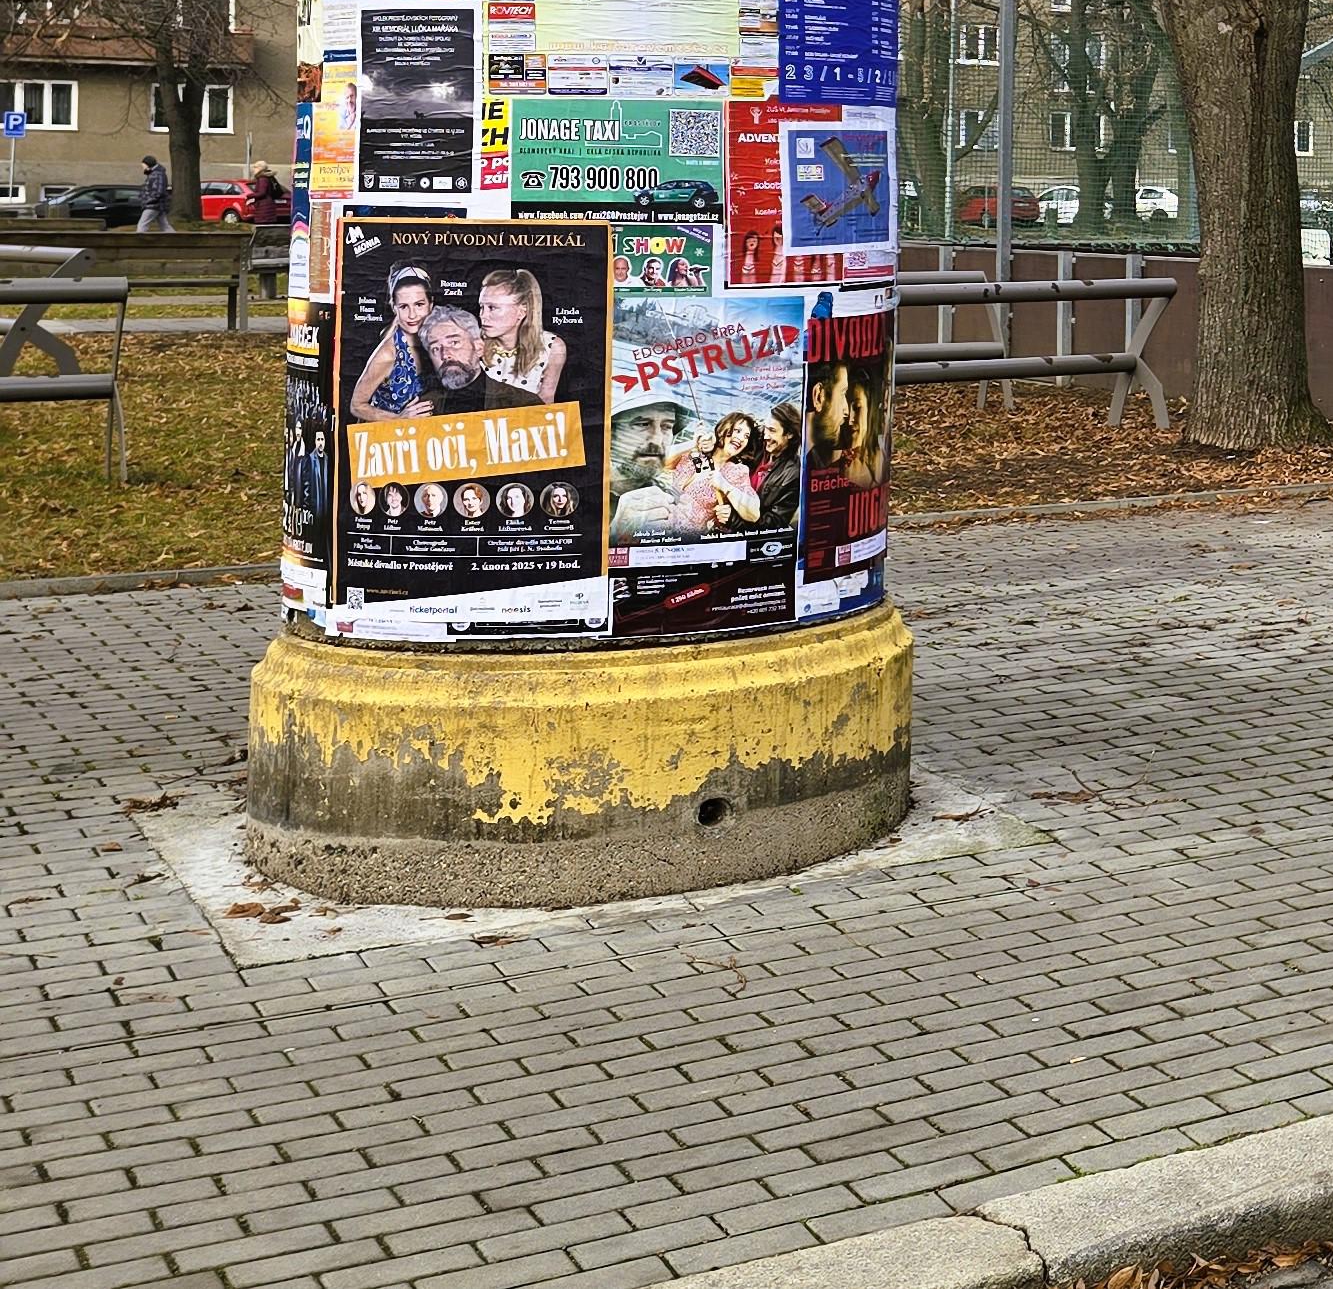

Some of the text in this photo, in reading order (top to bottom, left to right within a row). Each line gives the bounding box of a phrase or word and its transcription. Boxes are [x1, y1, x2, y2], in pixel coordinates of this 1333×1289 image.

[519, 117, 619, 141] JONAGE TAXI
[549, 165, 659, 191] 793 900 800
[392, 229, 586, 247] NOVÝ PŮVODNÍ MUZIKÁL
[623, 237, 686, 255] SHOW
[440, 280, 467, 289] Roman
[552, 307, 583, 326] Linda Rybová
[710, 322, 746, 341] ERBA
[353, 411, 569, 478] Zavři oči, Maxi!
[374, 559, 401, 570] divadlo
[408, 560, 454, 573] Prostějově
[471, 562, 480, 571] 2.
[482, 561, 510, 571] února
[511, 561, 536, 571] 2025
[545, 560, 558, 570] 19
[559, 559, 581, 569] hod.
[409, 605, 458, 615] ticketportal
[501, 605, 531, 614] noesis
